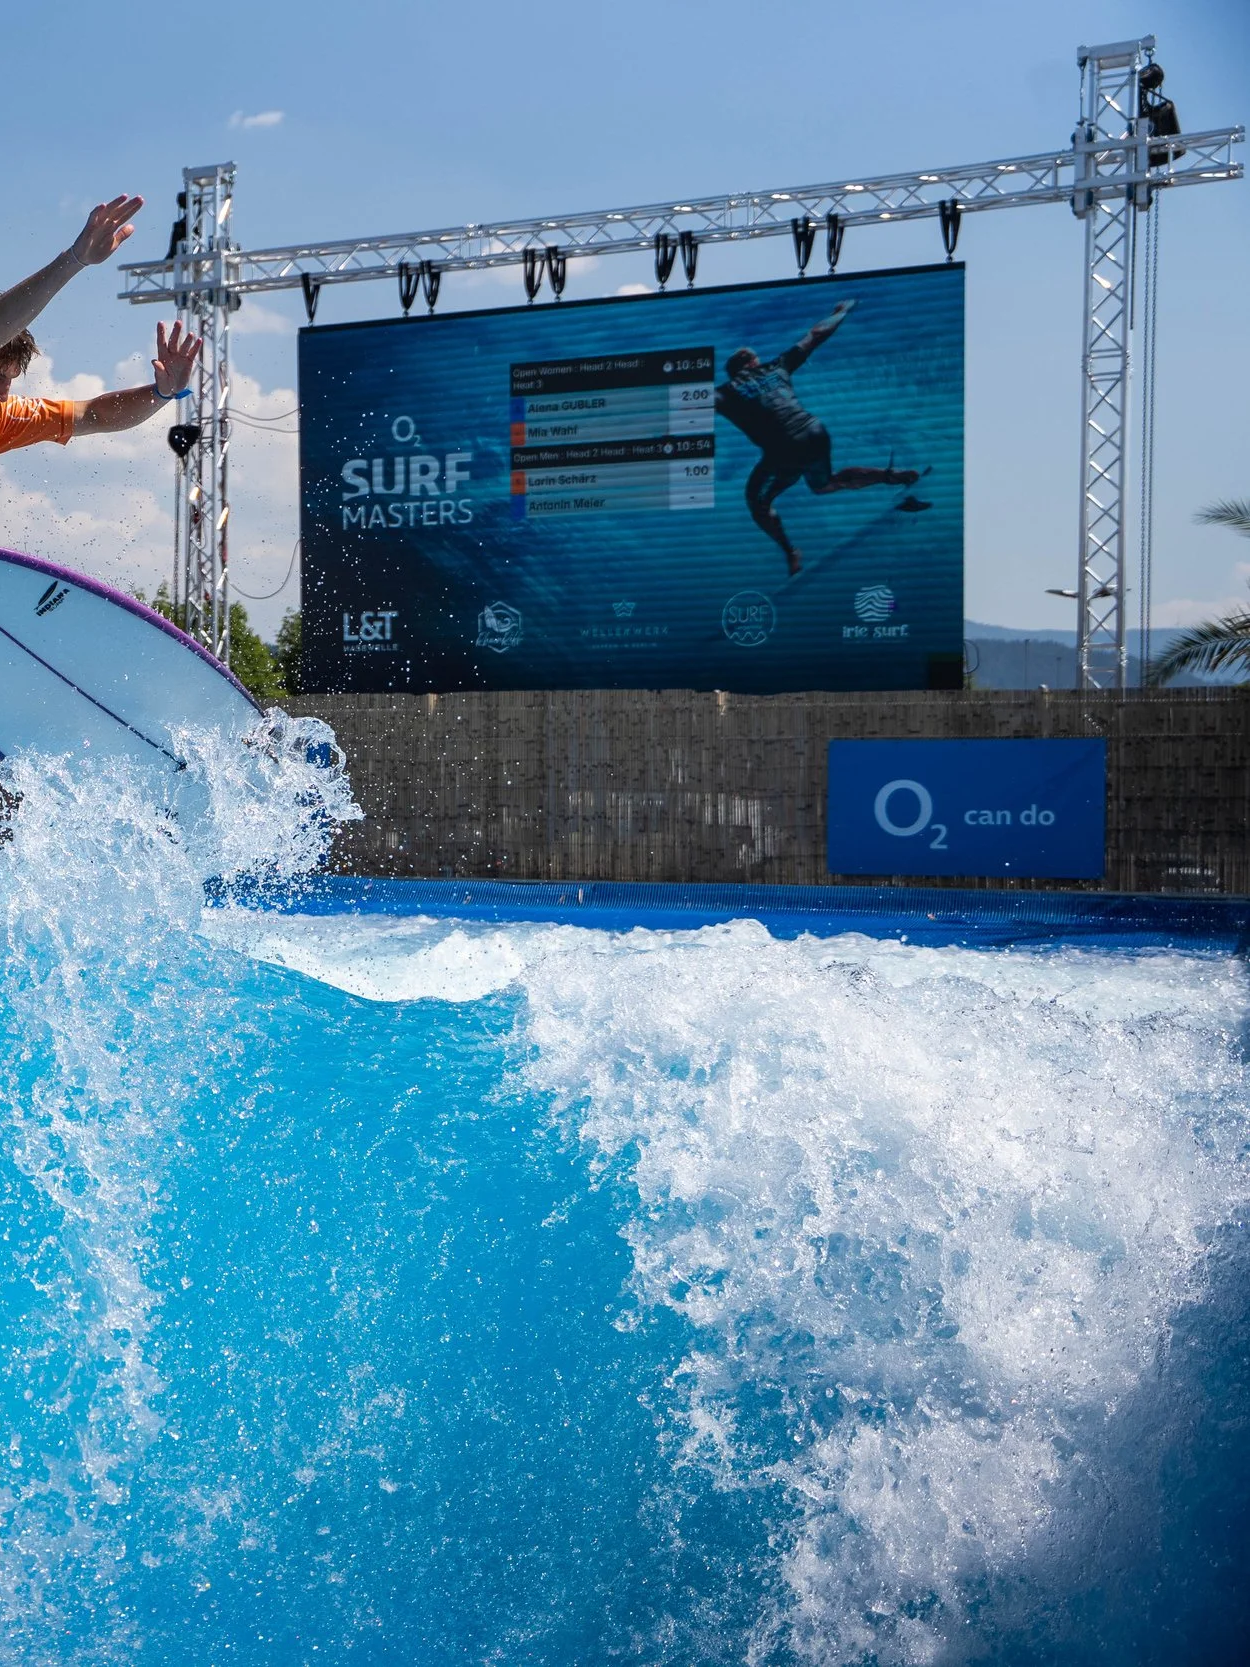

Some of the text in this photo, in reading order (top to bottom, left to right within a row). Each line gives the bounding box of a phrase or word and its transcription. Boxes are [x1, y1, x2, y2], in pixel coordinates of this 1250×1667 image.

[513, 368, 536, 378] Open
[539, 365, 572, 375] Women
[580, 362, 603, 372] Head
[606, 361, 612, 370] 2
[614, 359, 639, 369] Head
[513, 380, 542, 390] Heat 3
[561, 398, 606, 410] GUBLER
[682, 389, 709, 401] 2.00
[528, 427, 548, 438] Mia
[514, 453, 537, 463] Open
[539, 452, 559, 460] Men
[566, 449, 590, 459] Head
[592, 448, 598, 457] 2
[600, 446, 625, 456] Head
[632, 445, 654, 454] Heat
[657, 443, 663, 453] 3
[341, 452, 473, 501] SURF
[528, 473, 597, 487] Lorin Schärz
[684, 465, 709, 477] 1.00
[529, 498, 606, 511] Antonin Meier
[342, 499, 473, 531] MASTERS
[36, 588, 70, 617] INDIANA
[728, 604, 769, 624] SURF
[342, 610, 399, 641] L&T
[963, 808, 1012, 826] can
[1019, 804, 1056, 826] do
